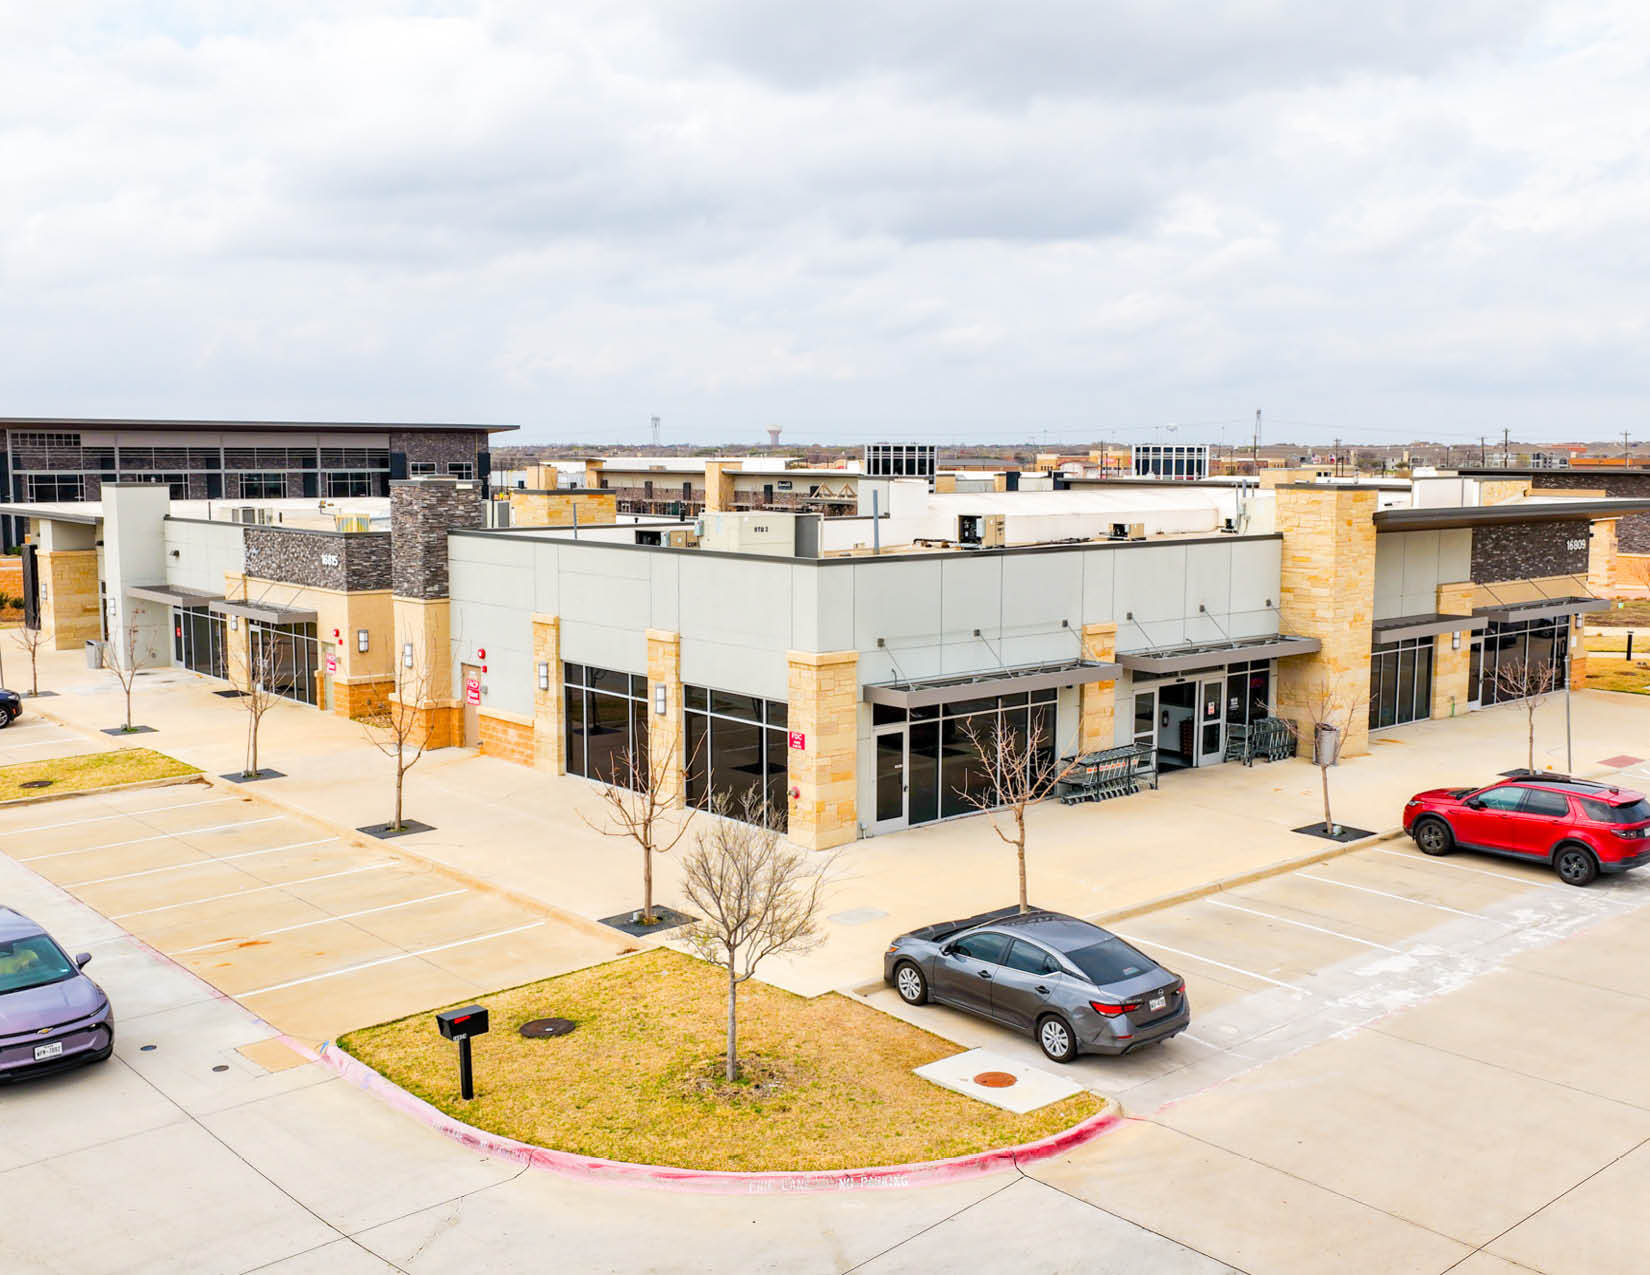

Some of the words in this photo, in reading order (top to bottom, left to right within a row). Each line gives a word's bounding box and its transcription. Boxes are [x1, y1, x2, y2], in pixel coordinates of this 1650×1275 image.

[1566, 538, 1586, 551] 16809
[838, 1178, 854, 1191] NO
[860, 1175, 909, 1189] PARKING
